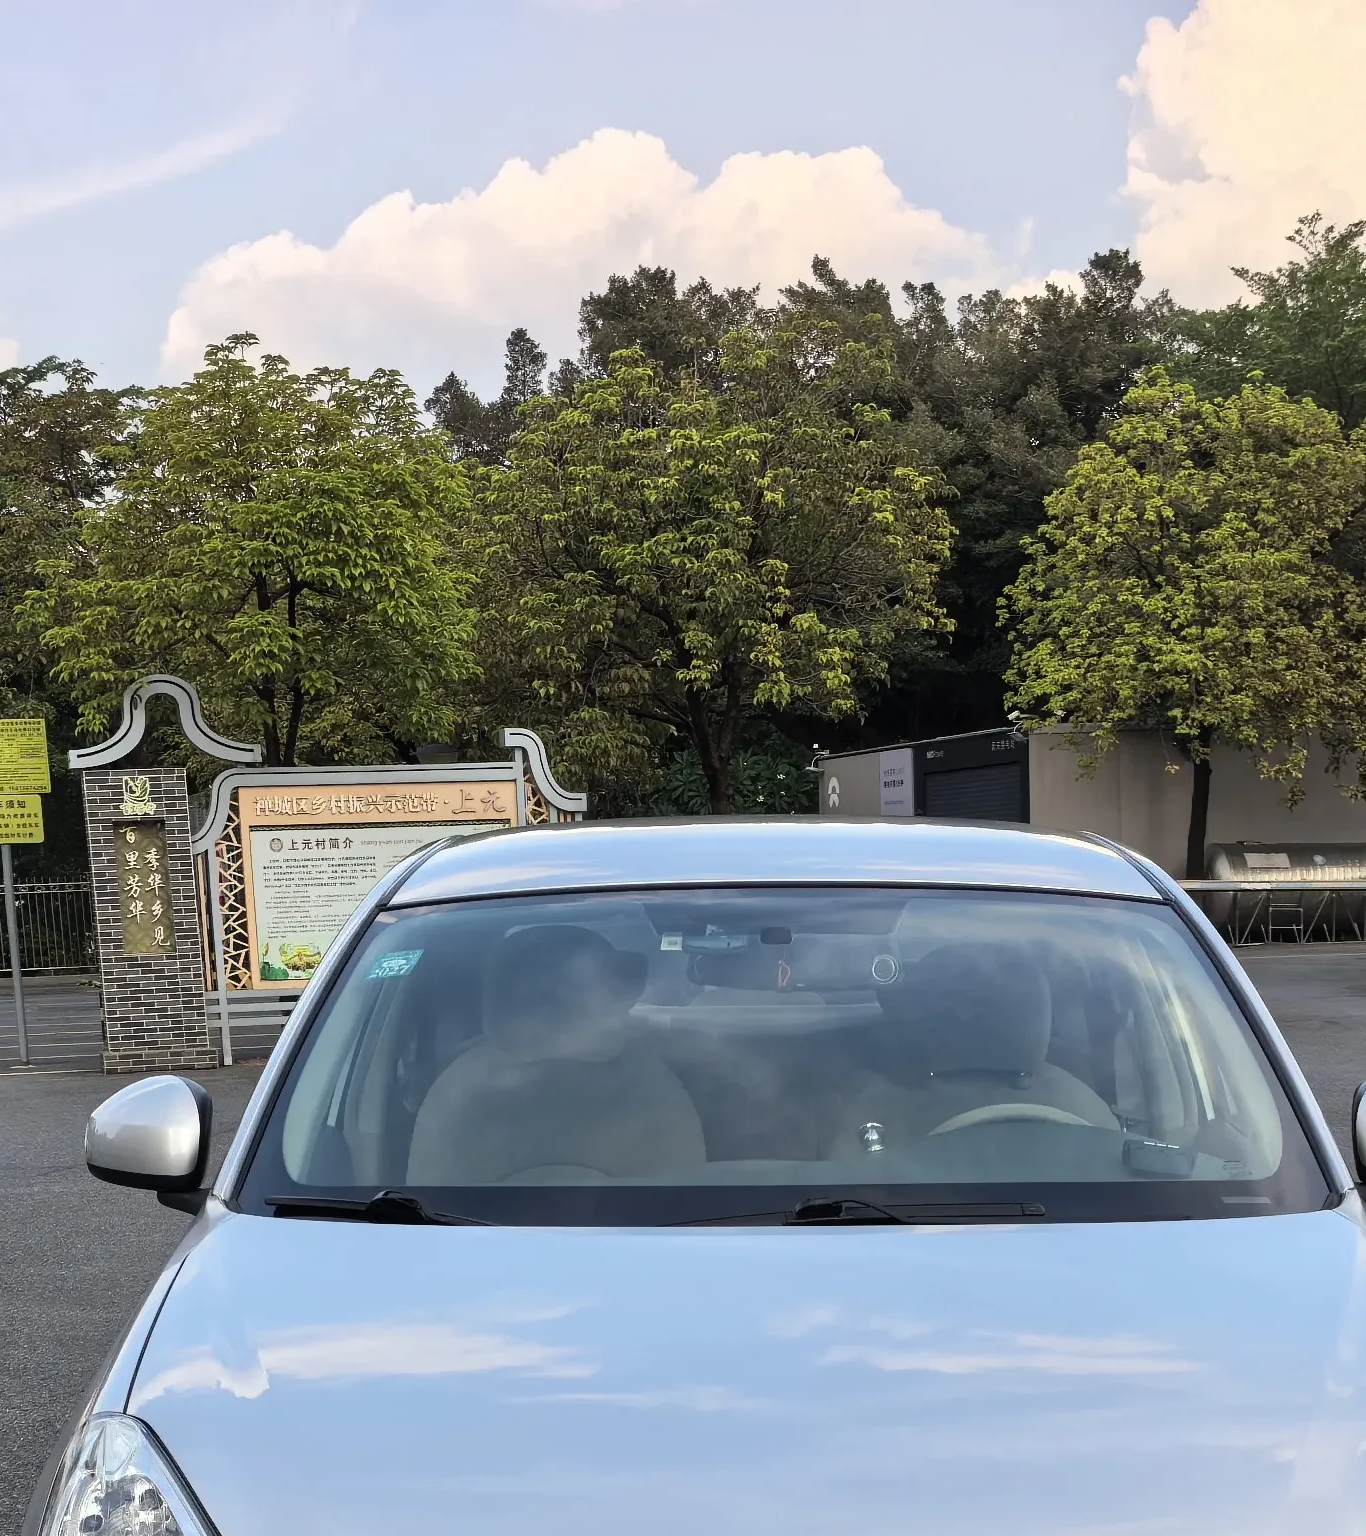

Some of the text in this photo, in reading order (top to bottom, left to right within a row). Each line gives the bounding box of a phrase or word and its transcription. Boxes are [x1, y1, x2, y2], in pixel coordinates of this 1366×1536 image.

[288, 837, 354, 851] 上元村简介
